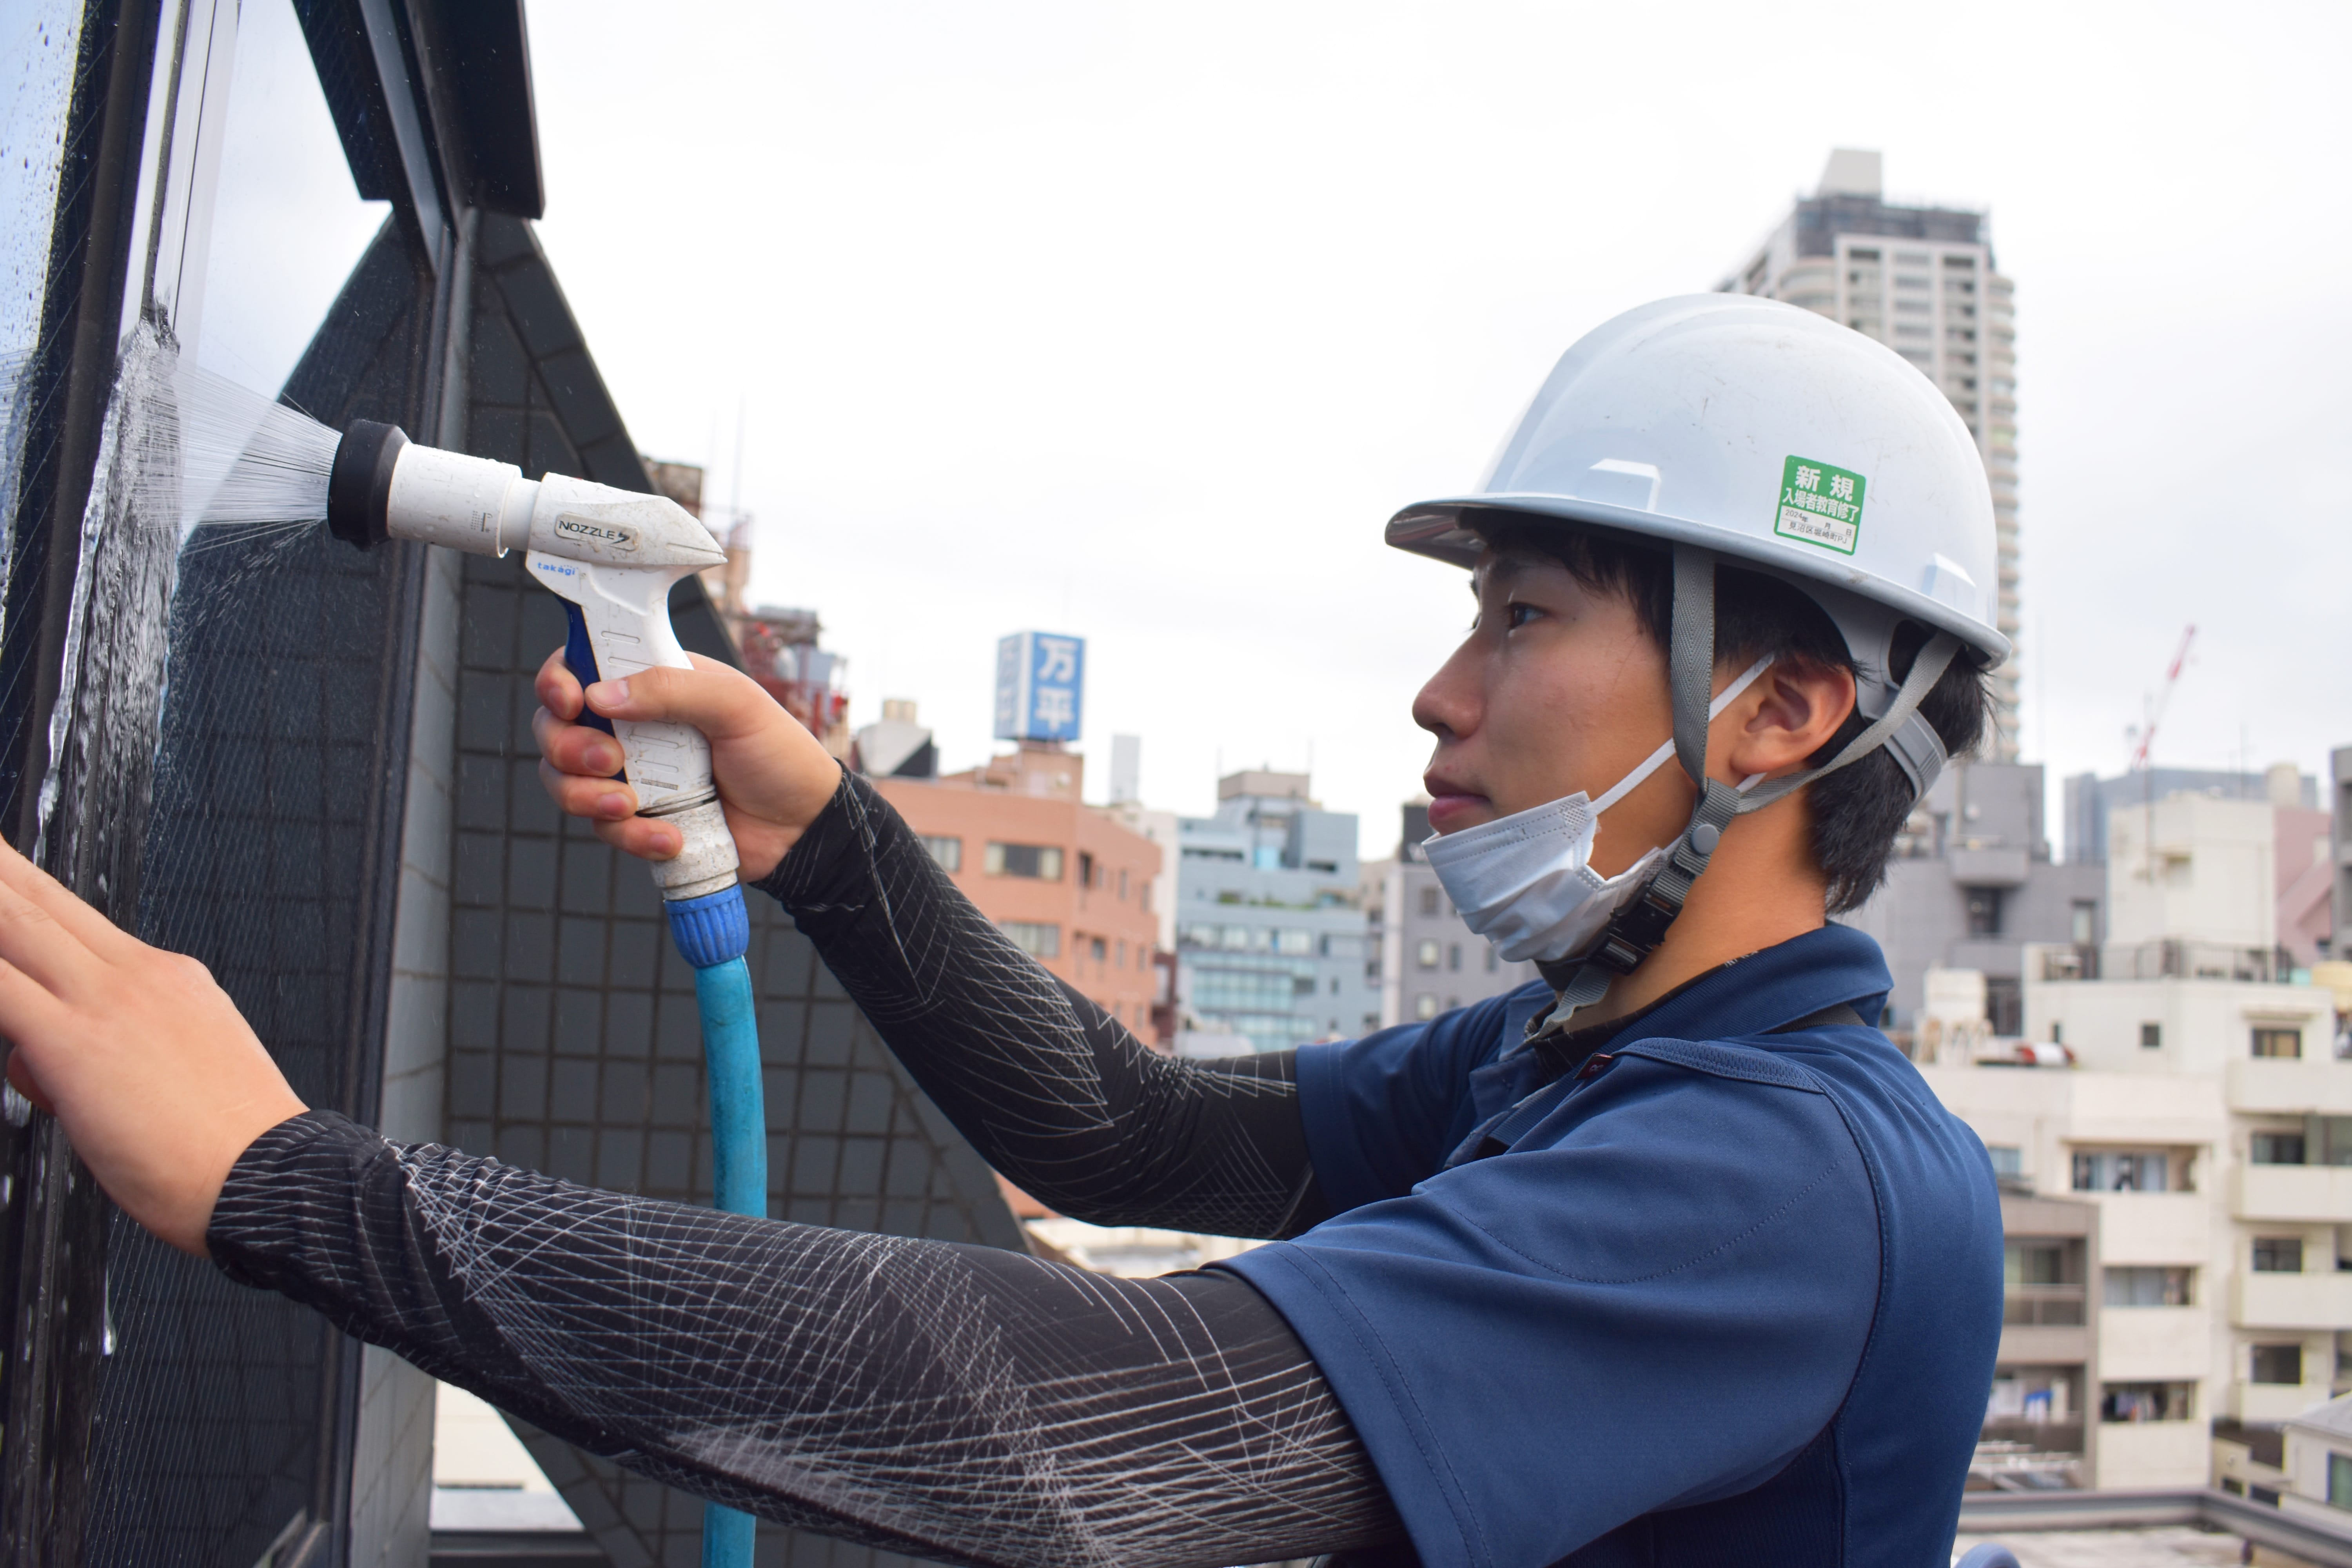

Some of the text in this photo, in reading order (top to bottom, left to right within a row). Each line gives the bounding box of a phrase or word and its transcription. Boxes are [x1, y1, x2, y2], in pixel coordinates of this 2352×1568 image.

[1782, 487, 1860, 522] 入場者教育修了
[1785, 509, 1808, 523] 2024年
[559, 520, 615, 540] NOZZLE
[537, 562, 575, 575] takagi
